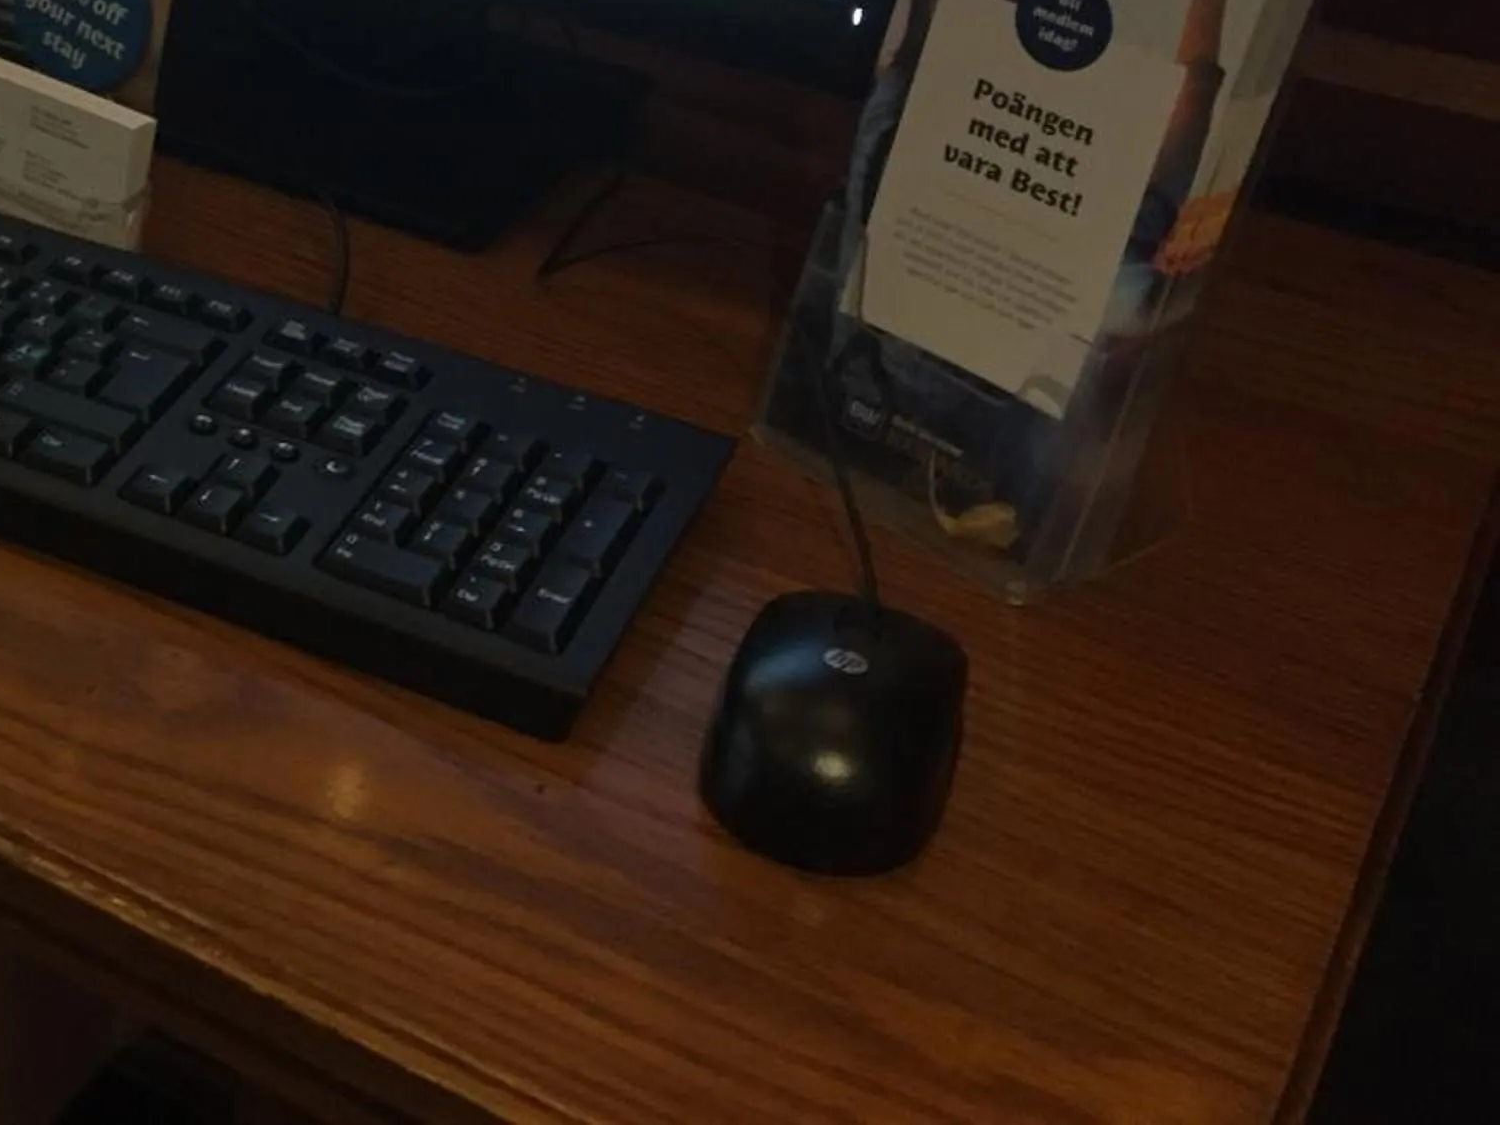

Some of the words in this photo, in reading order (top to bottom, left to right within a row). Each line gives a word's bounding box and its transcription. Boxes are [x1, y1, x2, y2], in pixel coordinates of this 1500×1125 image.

[92, 0, 130, 26] off
[41, 31, 87, 71] stay
[76, 20, 126, 61] next
[972, 77, 1094, 146] Poängen
[967, 117, 1031, 157] med
[1034, 145, 1079, 179] att
[943, 143, 1004, 185] vara
[1009, 168, 1084, 217] Best!
